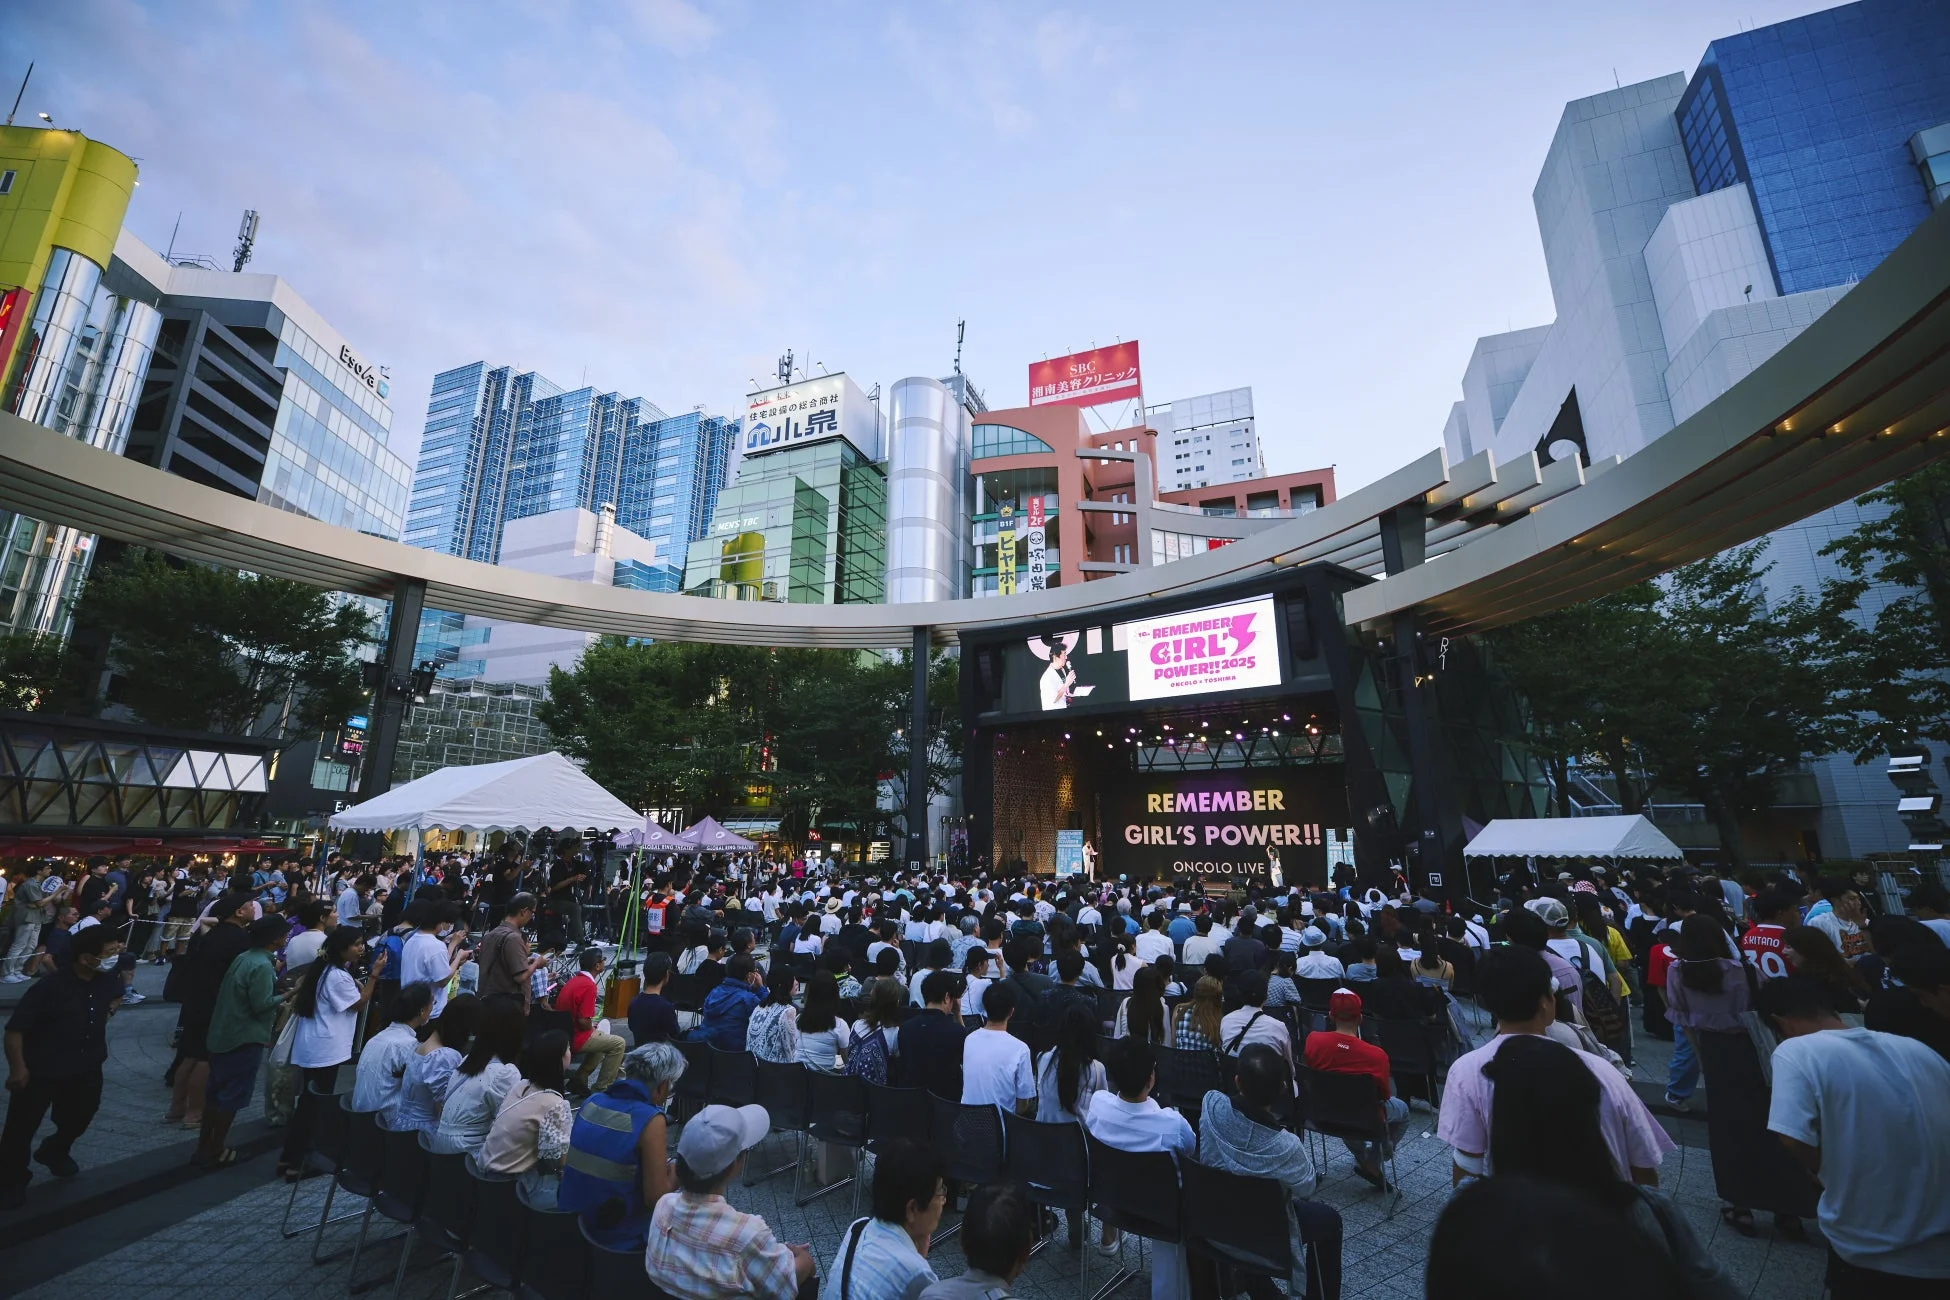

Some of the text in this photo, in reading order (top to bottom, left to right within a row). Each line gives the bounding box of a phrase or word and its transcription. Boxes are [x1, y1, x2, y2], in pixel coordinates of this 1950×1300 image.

[1070, 360, 1096, 373] SBC
[1032, 367, 1136, 398] 湘南美容クリニック
[750, 394, 838, 422] 住宅設備の総合商社
[772, 409, 838, 443] 小泉
[1030, 516, 1042, 525] 2F
[1153, 617, 1232, 639] REMEMBER
[1154, 656, 1256, 680] POWER!! 2025
[1204, 675, 1236, 684] TOSHIMA
[1147, 789, 1285, 813] REMEMBER
[1124, 823, 1321, 847] GIRL'S POWER!!
[1173, 862, 1265, 875] ONCOLO LIVE
